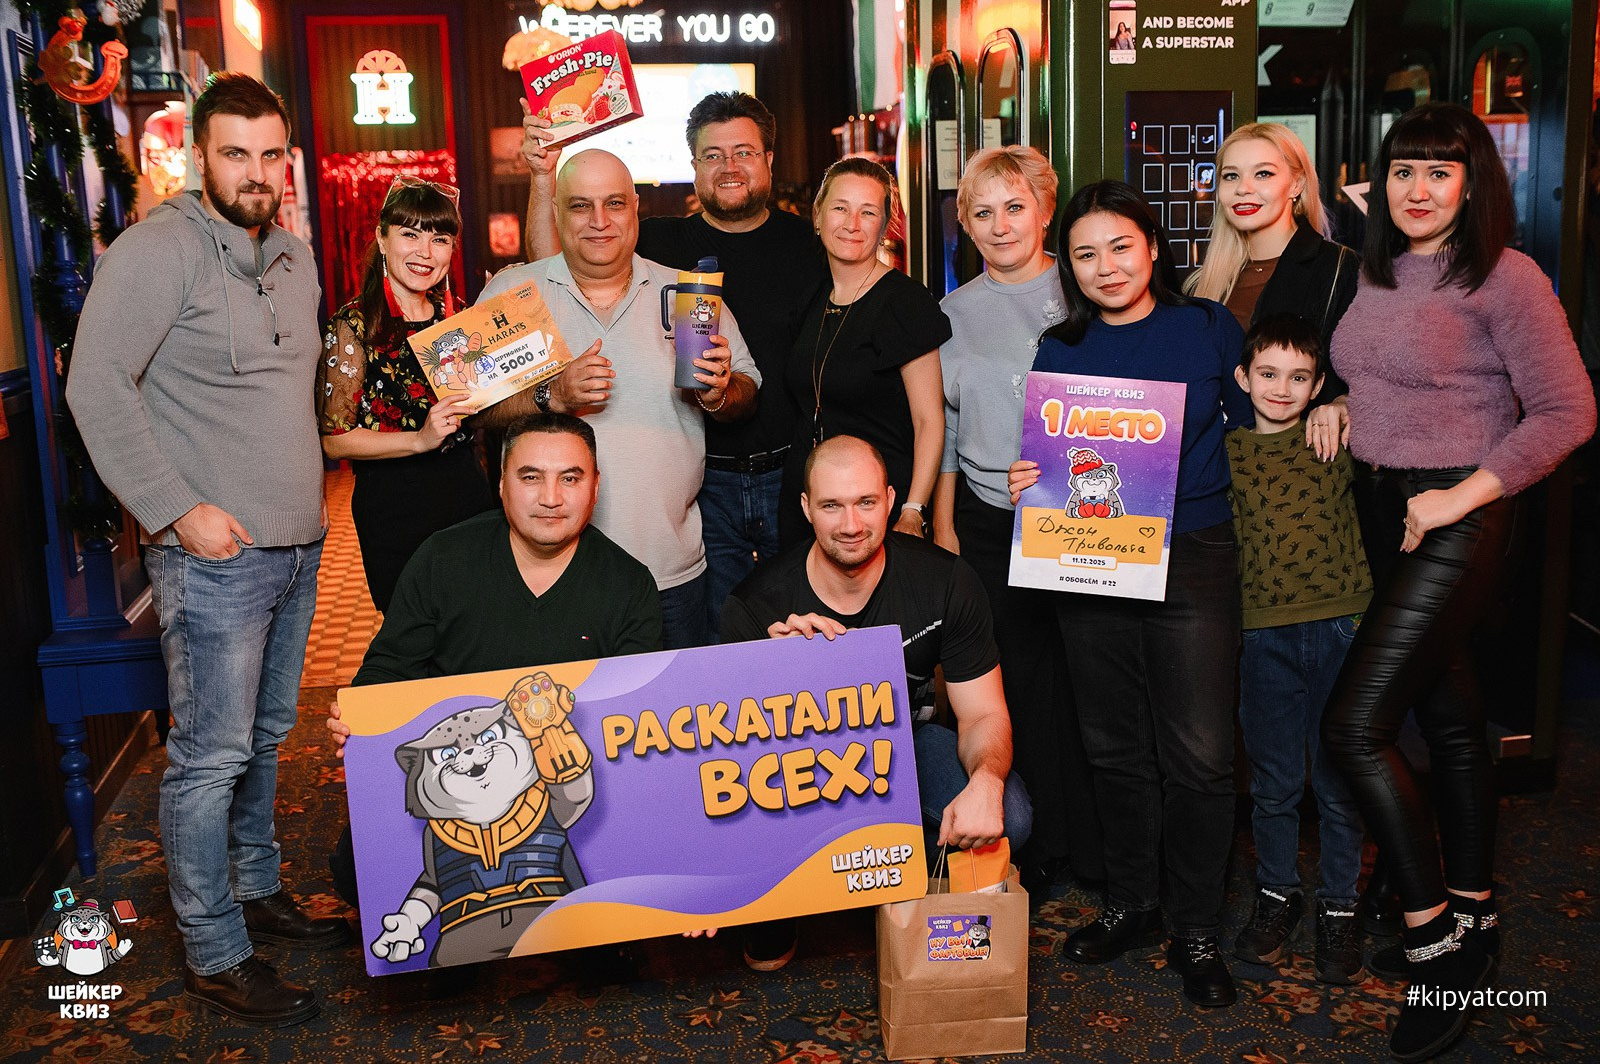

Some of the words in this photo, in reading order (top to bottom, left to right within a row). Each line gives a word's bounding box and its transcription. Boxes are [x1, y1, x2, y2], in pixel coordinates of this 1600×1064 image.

[676, 13, 731, 43] YOU
[738, 12, 776, 43] GO
[1142, 16, 1174, 29] AND
[1176, 16, 1234, 29] BECOME
[554, 44, 582, 61] ORION
[1142, 36, 1153, 49] A
[1155, 36, 1234, 49] SUPERSTAR
[494, 343, 529, 363] СЕРТИФИКАТ
[487, 372, 499, 381] НА
[499, 351, 535, 374] 5000
[1066, 384, 1111, 397] ШЕЙКЕР
[1114, 388, 1145, 400] КВИЗ
[1042, 400, 1063, 435] 1
[1065, 407, 1165, 442] МЕСТО
[1036, 514, 1098, 537] Джон
[1071, 557, 1106, 567] 11.12.2025
[601, 680, 896, 762] РАСКАТАЛИ
[699, 738, 893, 819] ВСЕХ!
[830, 843, 914, 873] ШЕЙКЕР
[846, 867, 902, 893] КВИЗ
[929, 937, 946, 949] НУ
[947, 936, 966, 948] ВЫ
[929, 946, 989, 959] ФАРТОВЫЕ!
